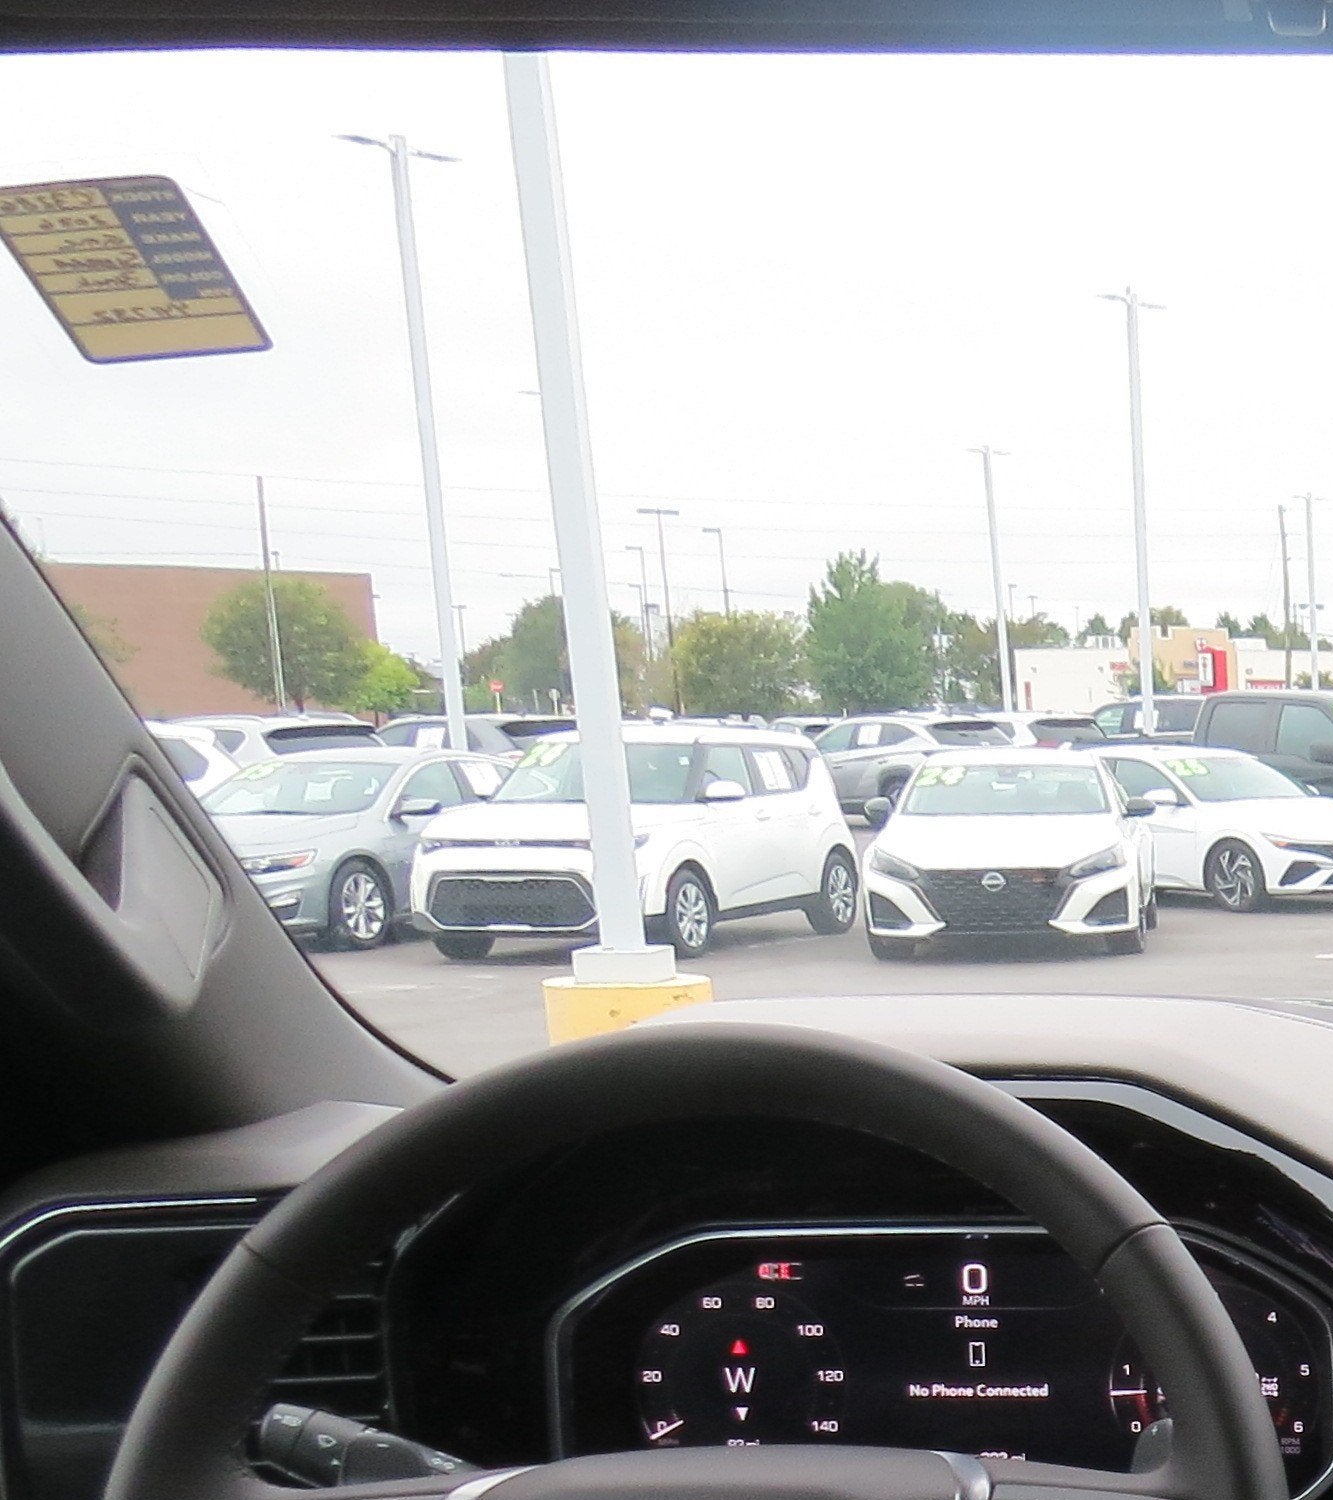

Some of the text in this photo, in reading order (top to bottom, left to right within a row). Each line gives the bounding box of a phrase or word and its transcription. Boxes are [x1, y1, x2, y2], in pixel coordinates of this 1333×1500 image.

[962, 1263, 988, 1294] 0
[702, 1297, 722, 1309] 60
[962, 1295, 990, 1306] MPH
[955, 1315, 999, 1329] Phone
[1267, 1311, 1278, 1323] 4
[660, 1324, 680, 1336] 40
[797, 1324, 824, 1336] 100
[817, 1370, 844, 1382] 120
[1299, 1364, 1310, 1376] 5
[642, 1370, 663, 1383] 20
[724, 1367, 756, 1394] W
[909, 1384, 1050, 1397] No Phone Connected
[812, 1421, 839, 1432] 140
[1293, 1421, 1304, 1433] 6
